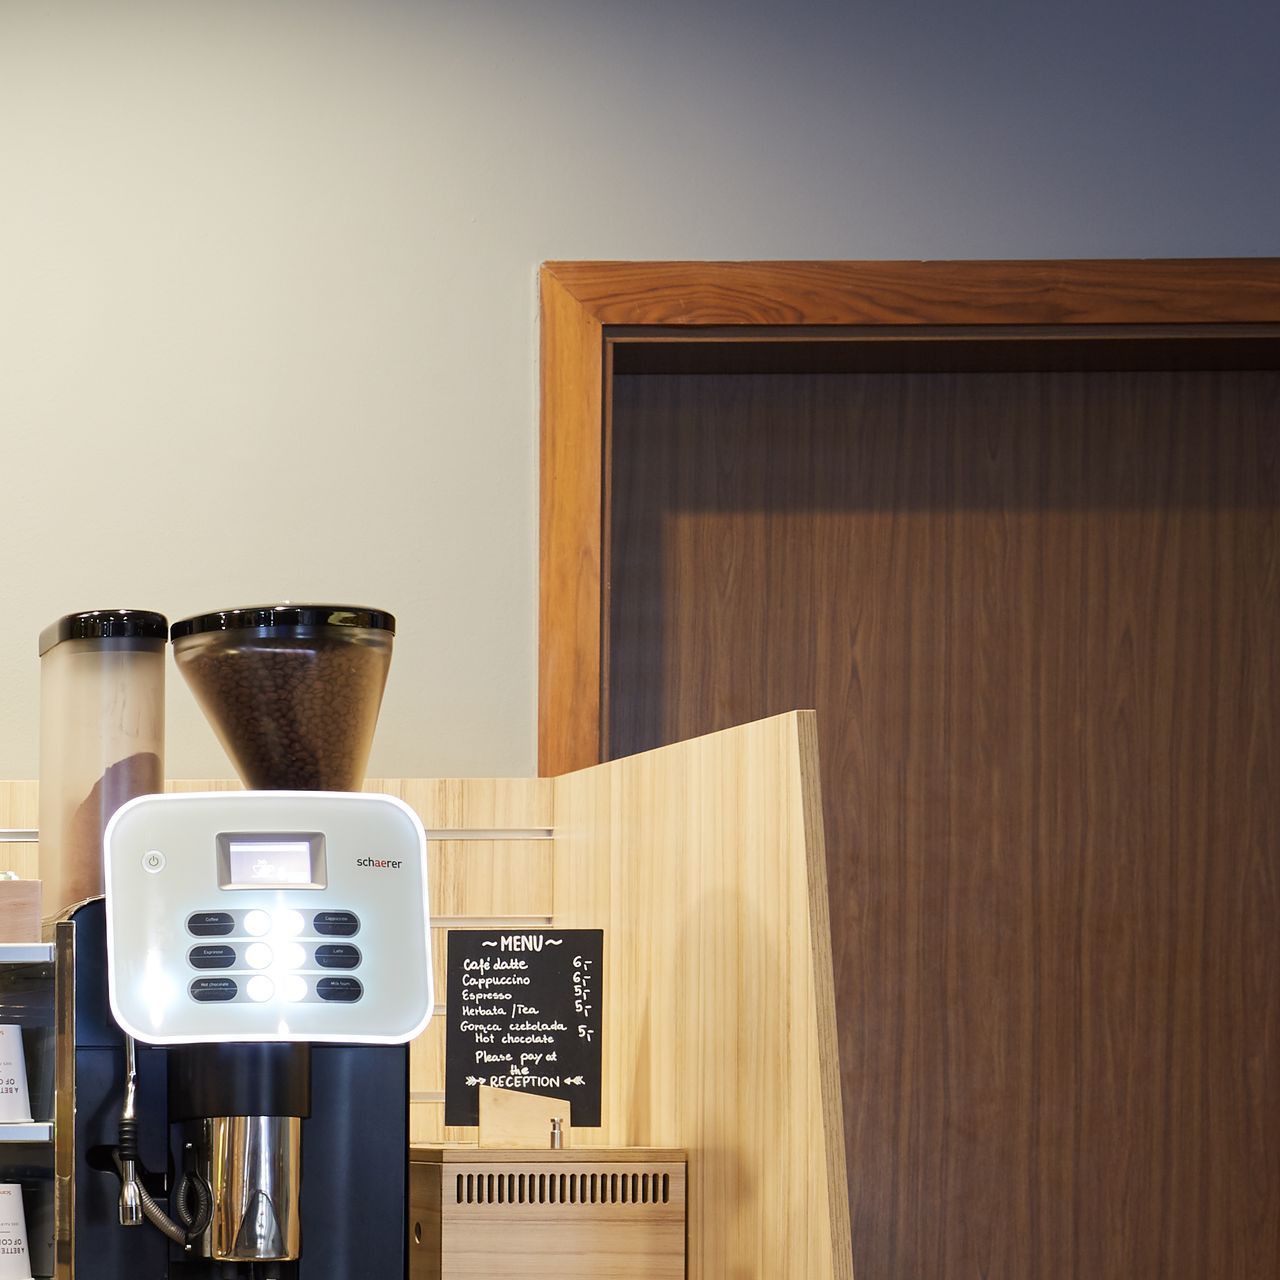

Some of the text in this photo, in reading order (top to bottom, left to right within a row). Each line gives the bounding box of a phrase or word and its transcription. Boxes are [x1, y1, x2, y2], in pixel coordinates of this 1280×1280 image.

[357, 857, 402, 869] schaerer
[501, 935, 544, 952] MENU
[464, 957, 490, 975] Café
[462, 975, 531, 989] Cappuccino
[462, 990, 512, 1004] Espresso
[462, 1005, 507, 1016] Herbata
[460, 1021, 502, 1034] Gorąca
[509, 1021, 567, 1032] czekolada
[475, 1033, 554, 1044] Hot chocolate
[475, 1051, 557, 1066] Please pay at
[510, 1065, 530, 1076] the
[490, 1076, 560, 1088] RECEPTION
